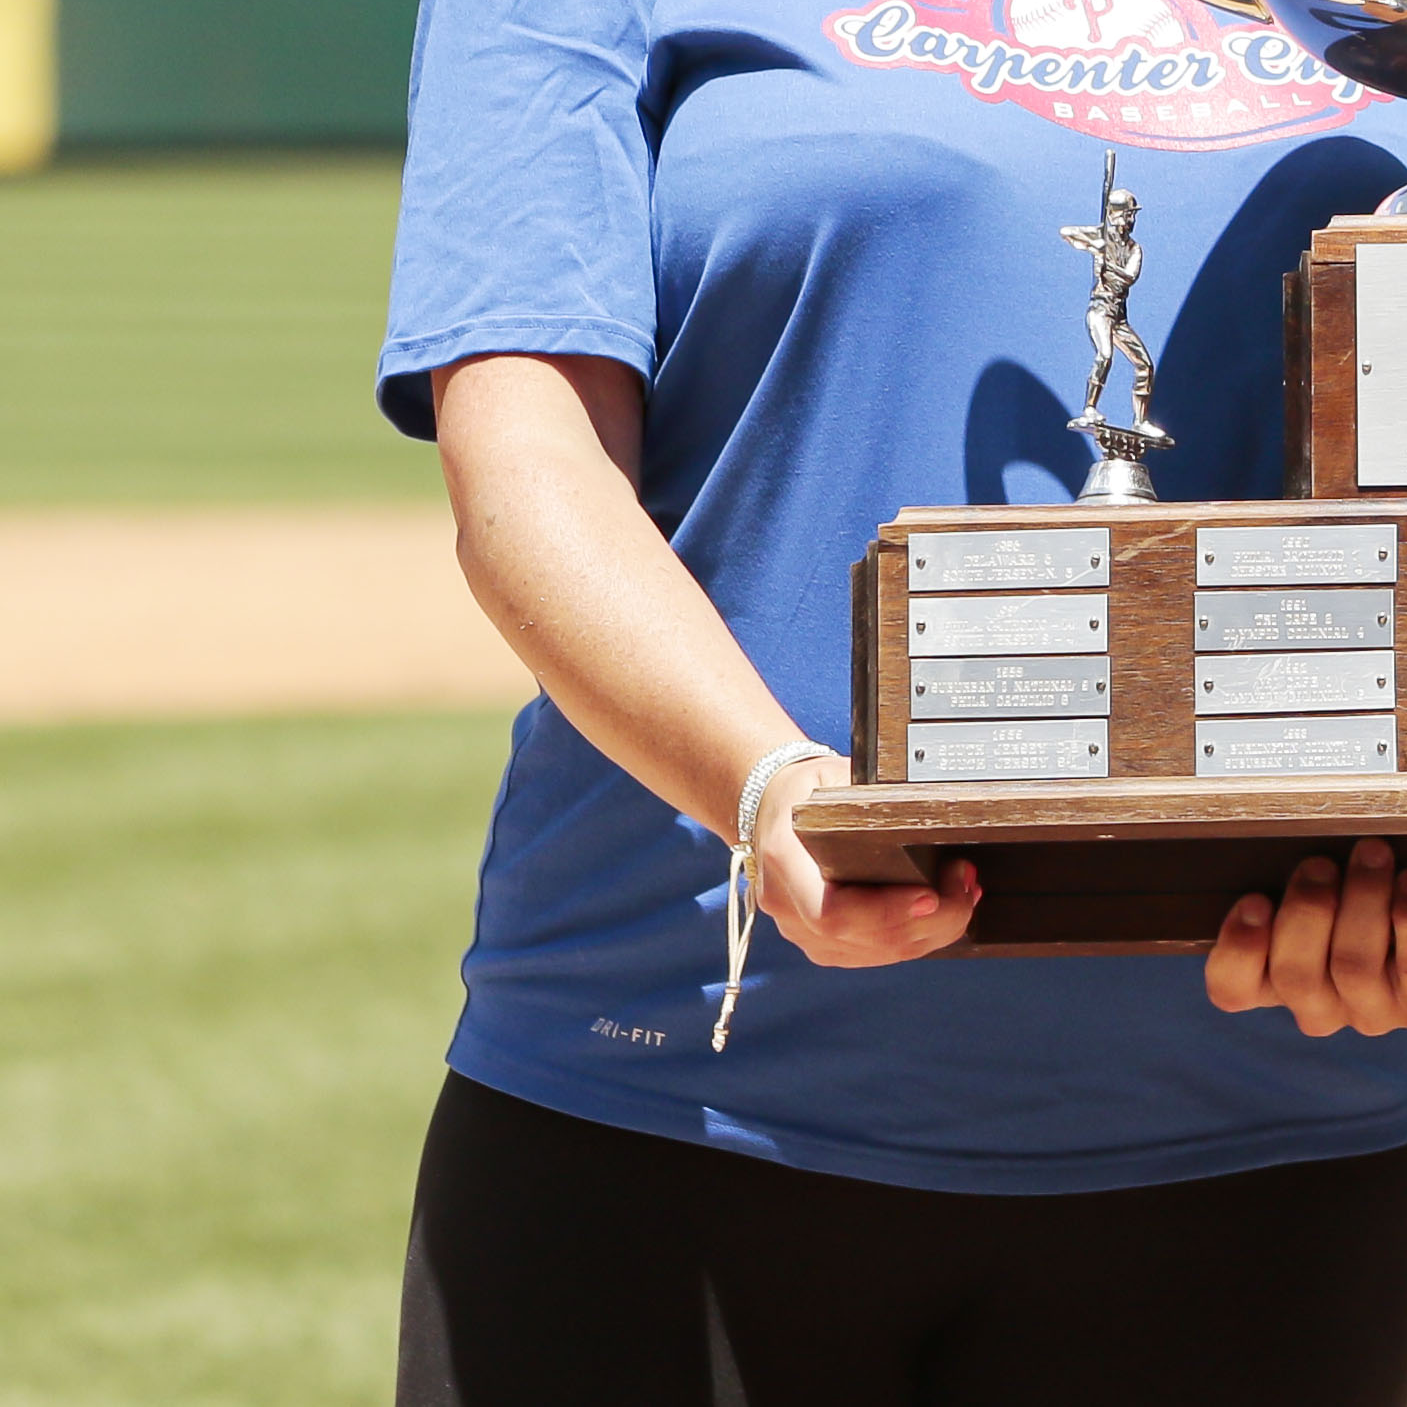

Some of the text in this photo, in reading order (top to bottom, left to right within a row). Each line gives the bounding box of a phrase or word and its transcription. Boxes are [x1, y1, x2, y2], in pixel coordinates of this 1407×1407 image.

[842, 2, 1220, 95] Carpenter
[1053, 94, 1312, 124] BASEBALL
[963, 553, 1037, 567] DELAWARE
[589, 1016, 667, 1047] DRI-FIT
